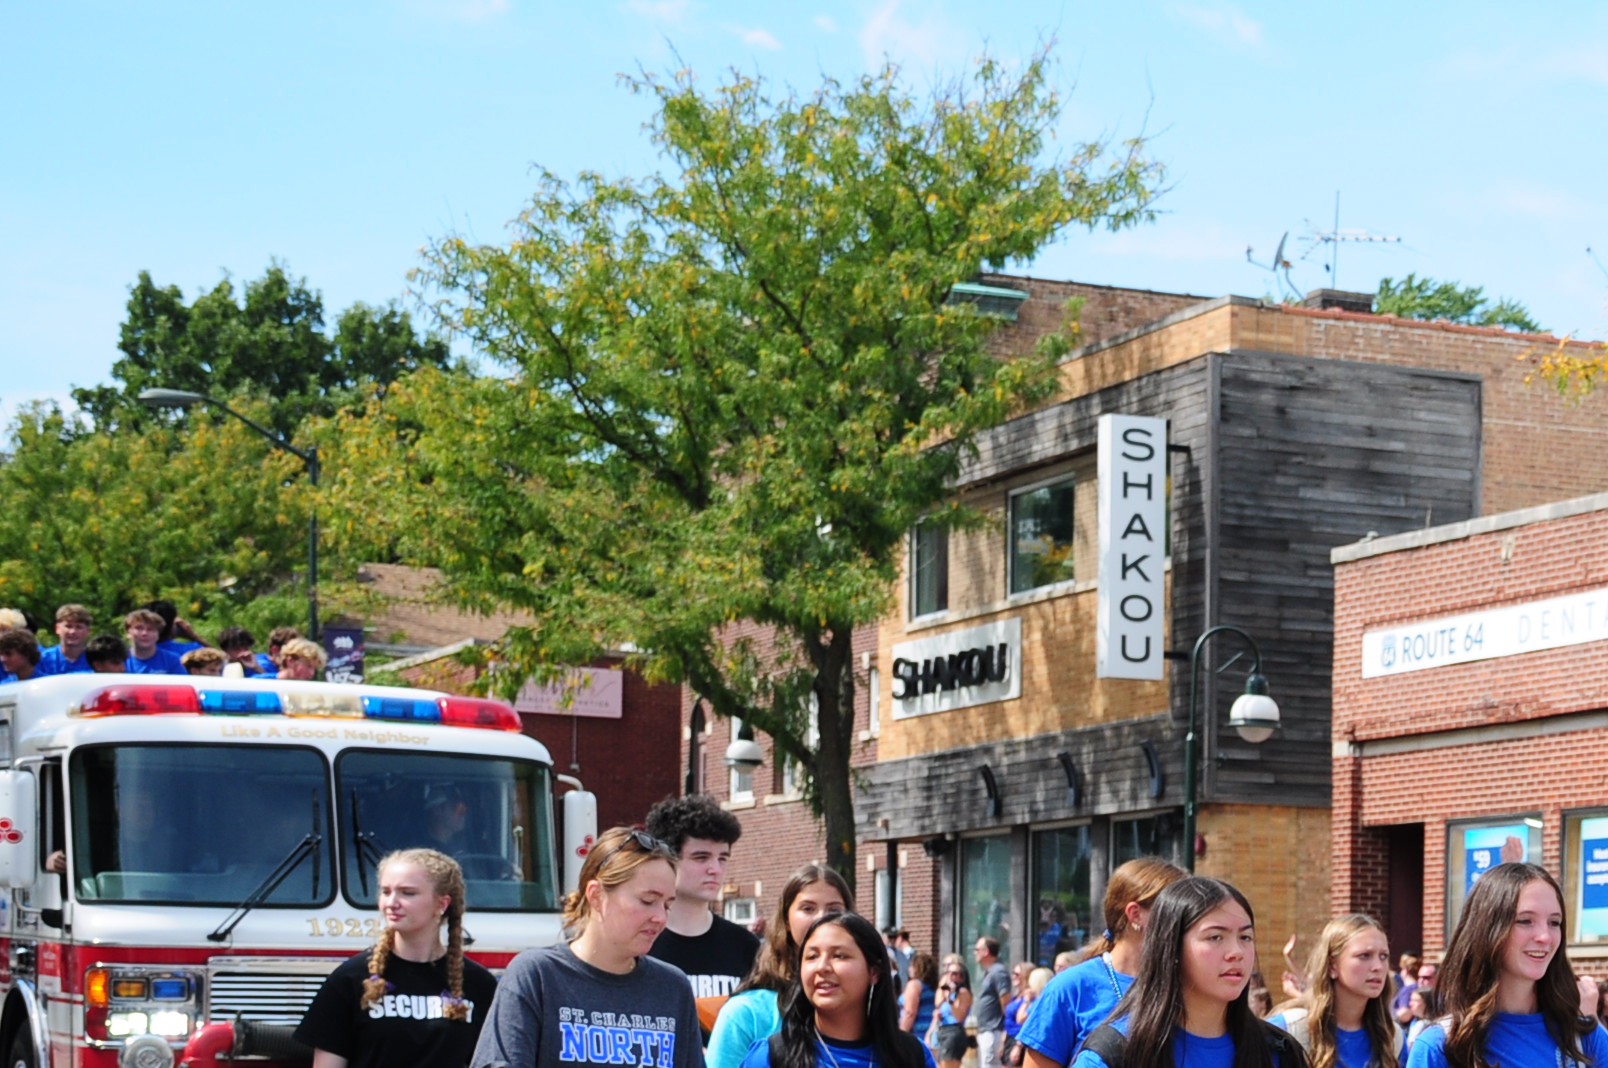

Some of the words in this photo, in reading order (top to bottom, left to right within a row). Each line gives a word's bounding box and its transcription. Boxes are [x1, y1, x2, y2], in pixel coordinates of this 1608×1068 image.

[1120, 427, 1155, 664] SHAKOU
[1401, 626, 1457, 665] ROUTE
[1463, 622, 1484, 653] 64
[891, 642, 1008, 700] SHAKOU
[221, 725, 260, 738] Like
[267, 726, 282, 738] A
[287, 727, 338, 739] Good
[344, 729, 430, 745] Neighbor
[306, 917, 383, 938] 1922
[559, 1006, 589, 1024] ST.
[591, 1011, 677, 1033] CHARLES
